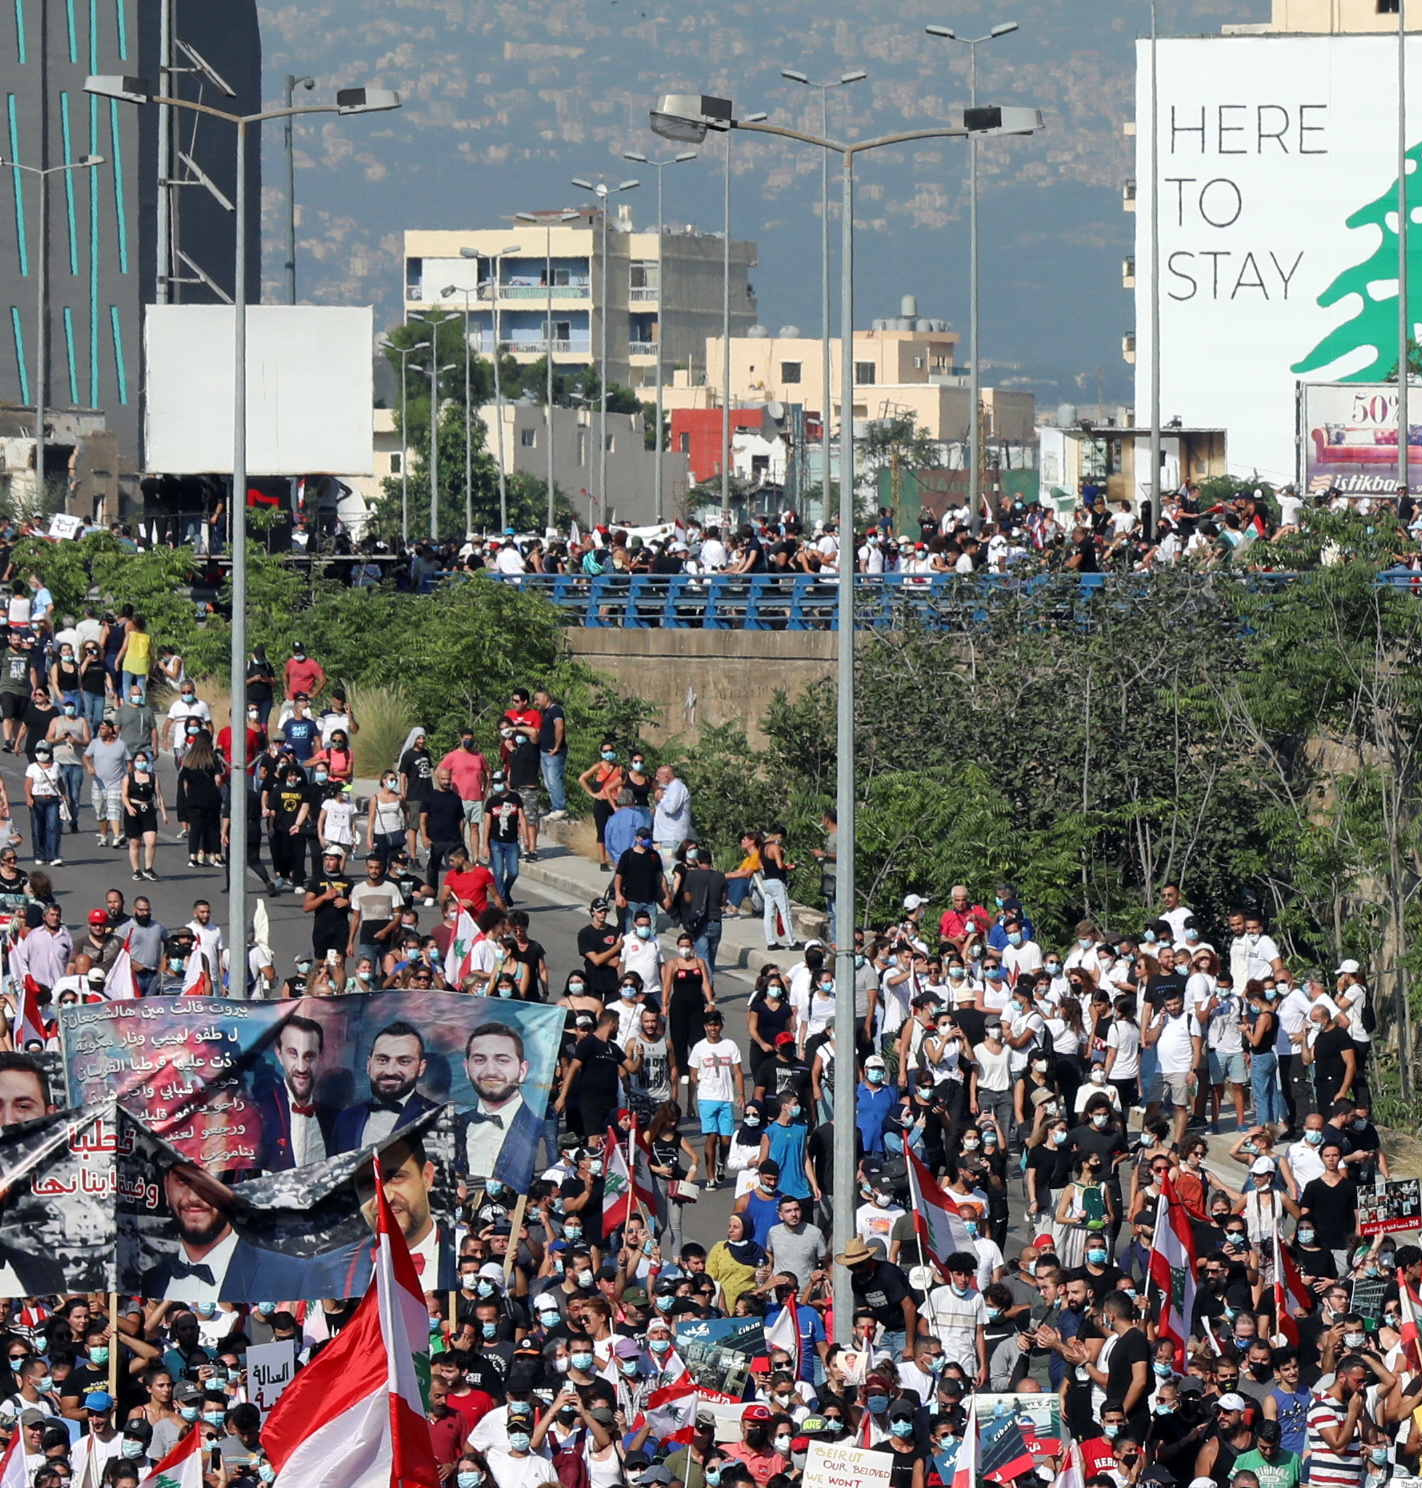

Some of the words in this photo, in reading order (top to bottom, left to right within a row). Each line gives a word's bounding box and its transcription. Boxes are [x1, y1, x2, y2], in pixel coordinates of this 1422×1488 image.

[1171, 105, 1328, 154] HERE
[1164, 178, 1242, 228] TO
[1168, 251, 1304, 301] STAY
[141, 1005, 165, 1021] مين
[170, 1001, 204, 1015] قالت
[209, 1002, 249, 1018] بيروت
[120, 1031, 146, 1048] ونار
[76, 1061, 125, 1081] الفرسان
[130, 1055, 167, 1074] قرطبا
[813, 1447, 865, 1465] BEIRUT
[805, 1471, 824, 1483] WE
[822, 1459, 849, 1472] OUR
[852, 1465, 890, 1480] BELOVED
